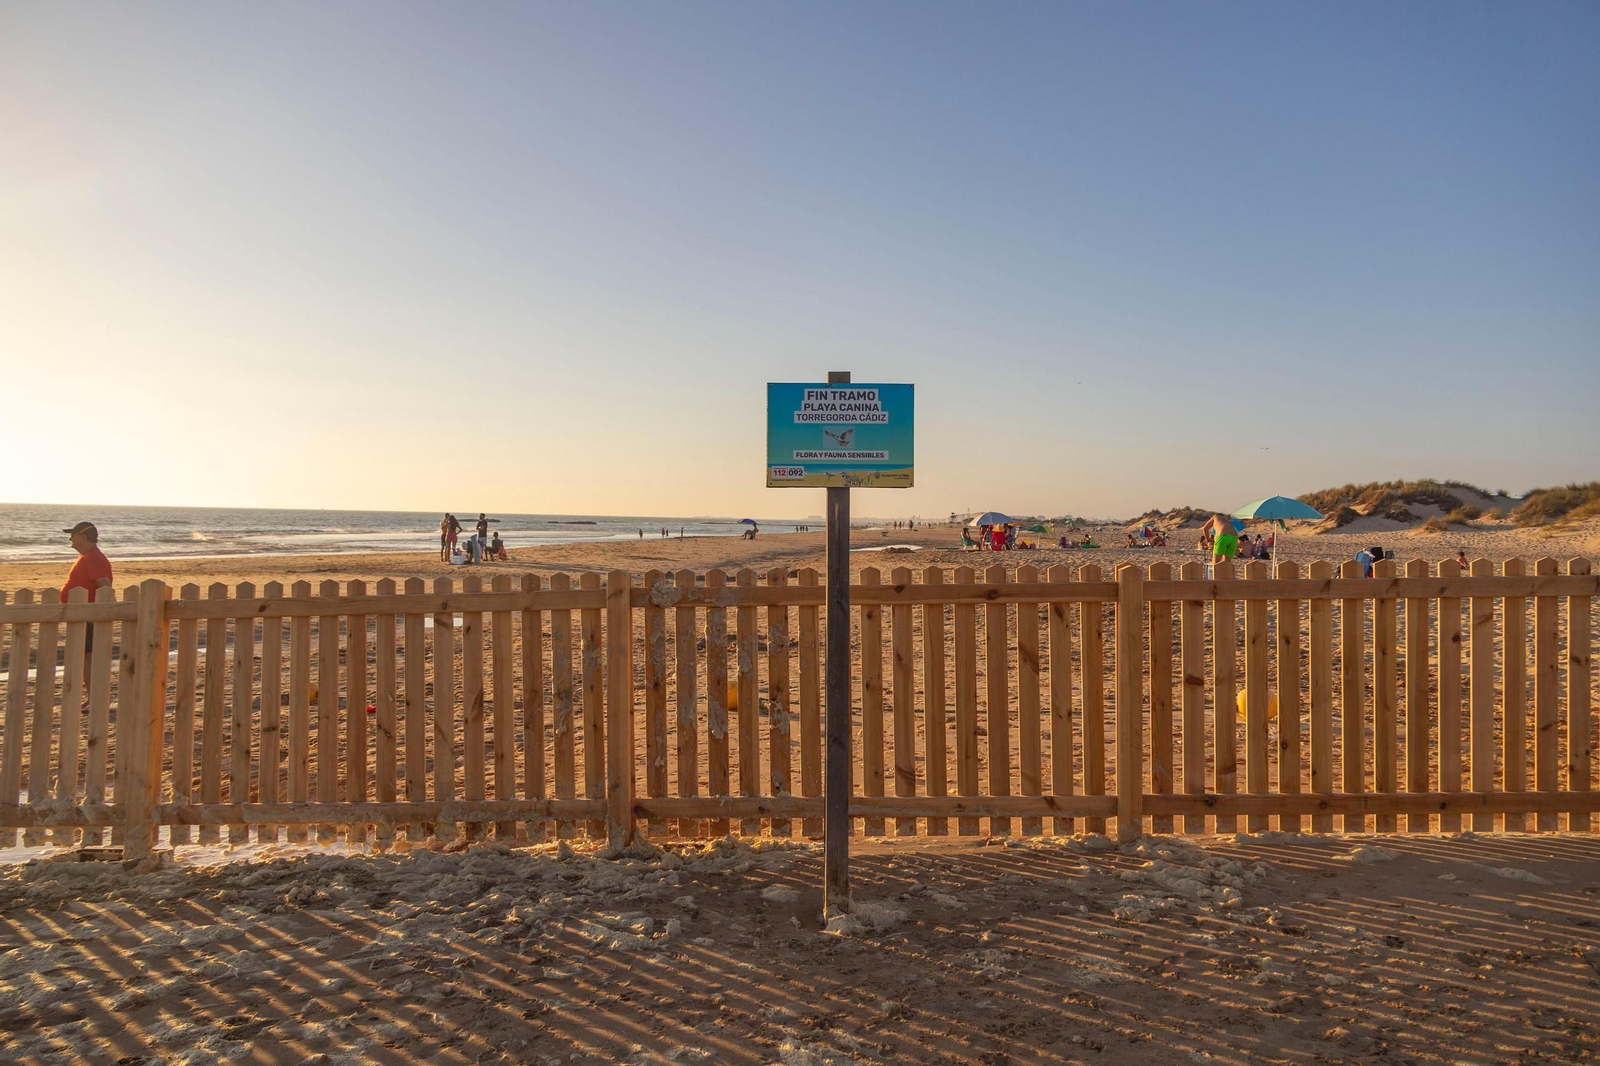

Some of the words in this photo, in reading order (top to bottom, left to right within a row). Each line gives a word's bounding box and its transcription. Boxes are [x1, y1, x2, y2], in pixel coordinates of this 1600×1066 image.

[807, 391, 828, 401] FIN
[831, 391, 876, 401] TRAMO
[804, 403, 837, 411] PLAYA
[839, 403, 880, 411] CANINA
[796, 413, 857, 421] TORREGORDA
[859, 412, 887, 421] CÁDIZ
